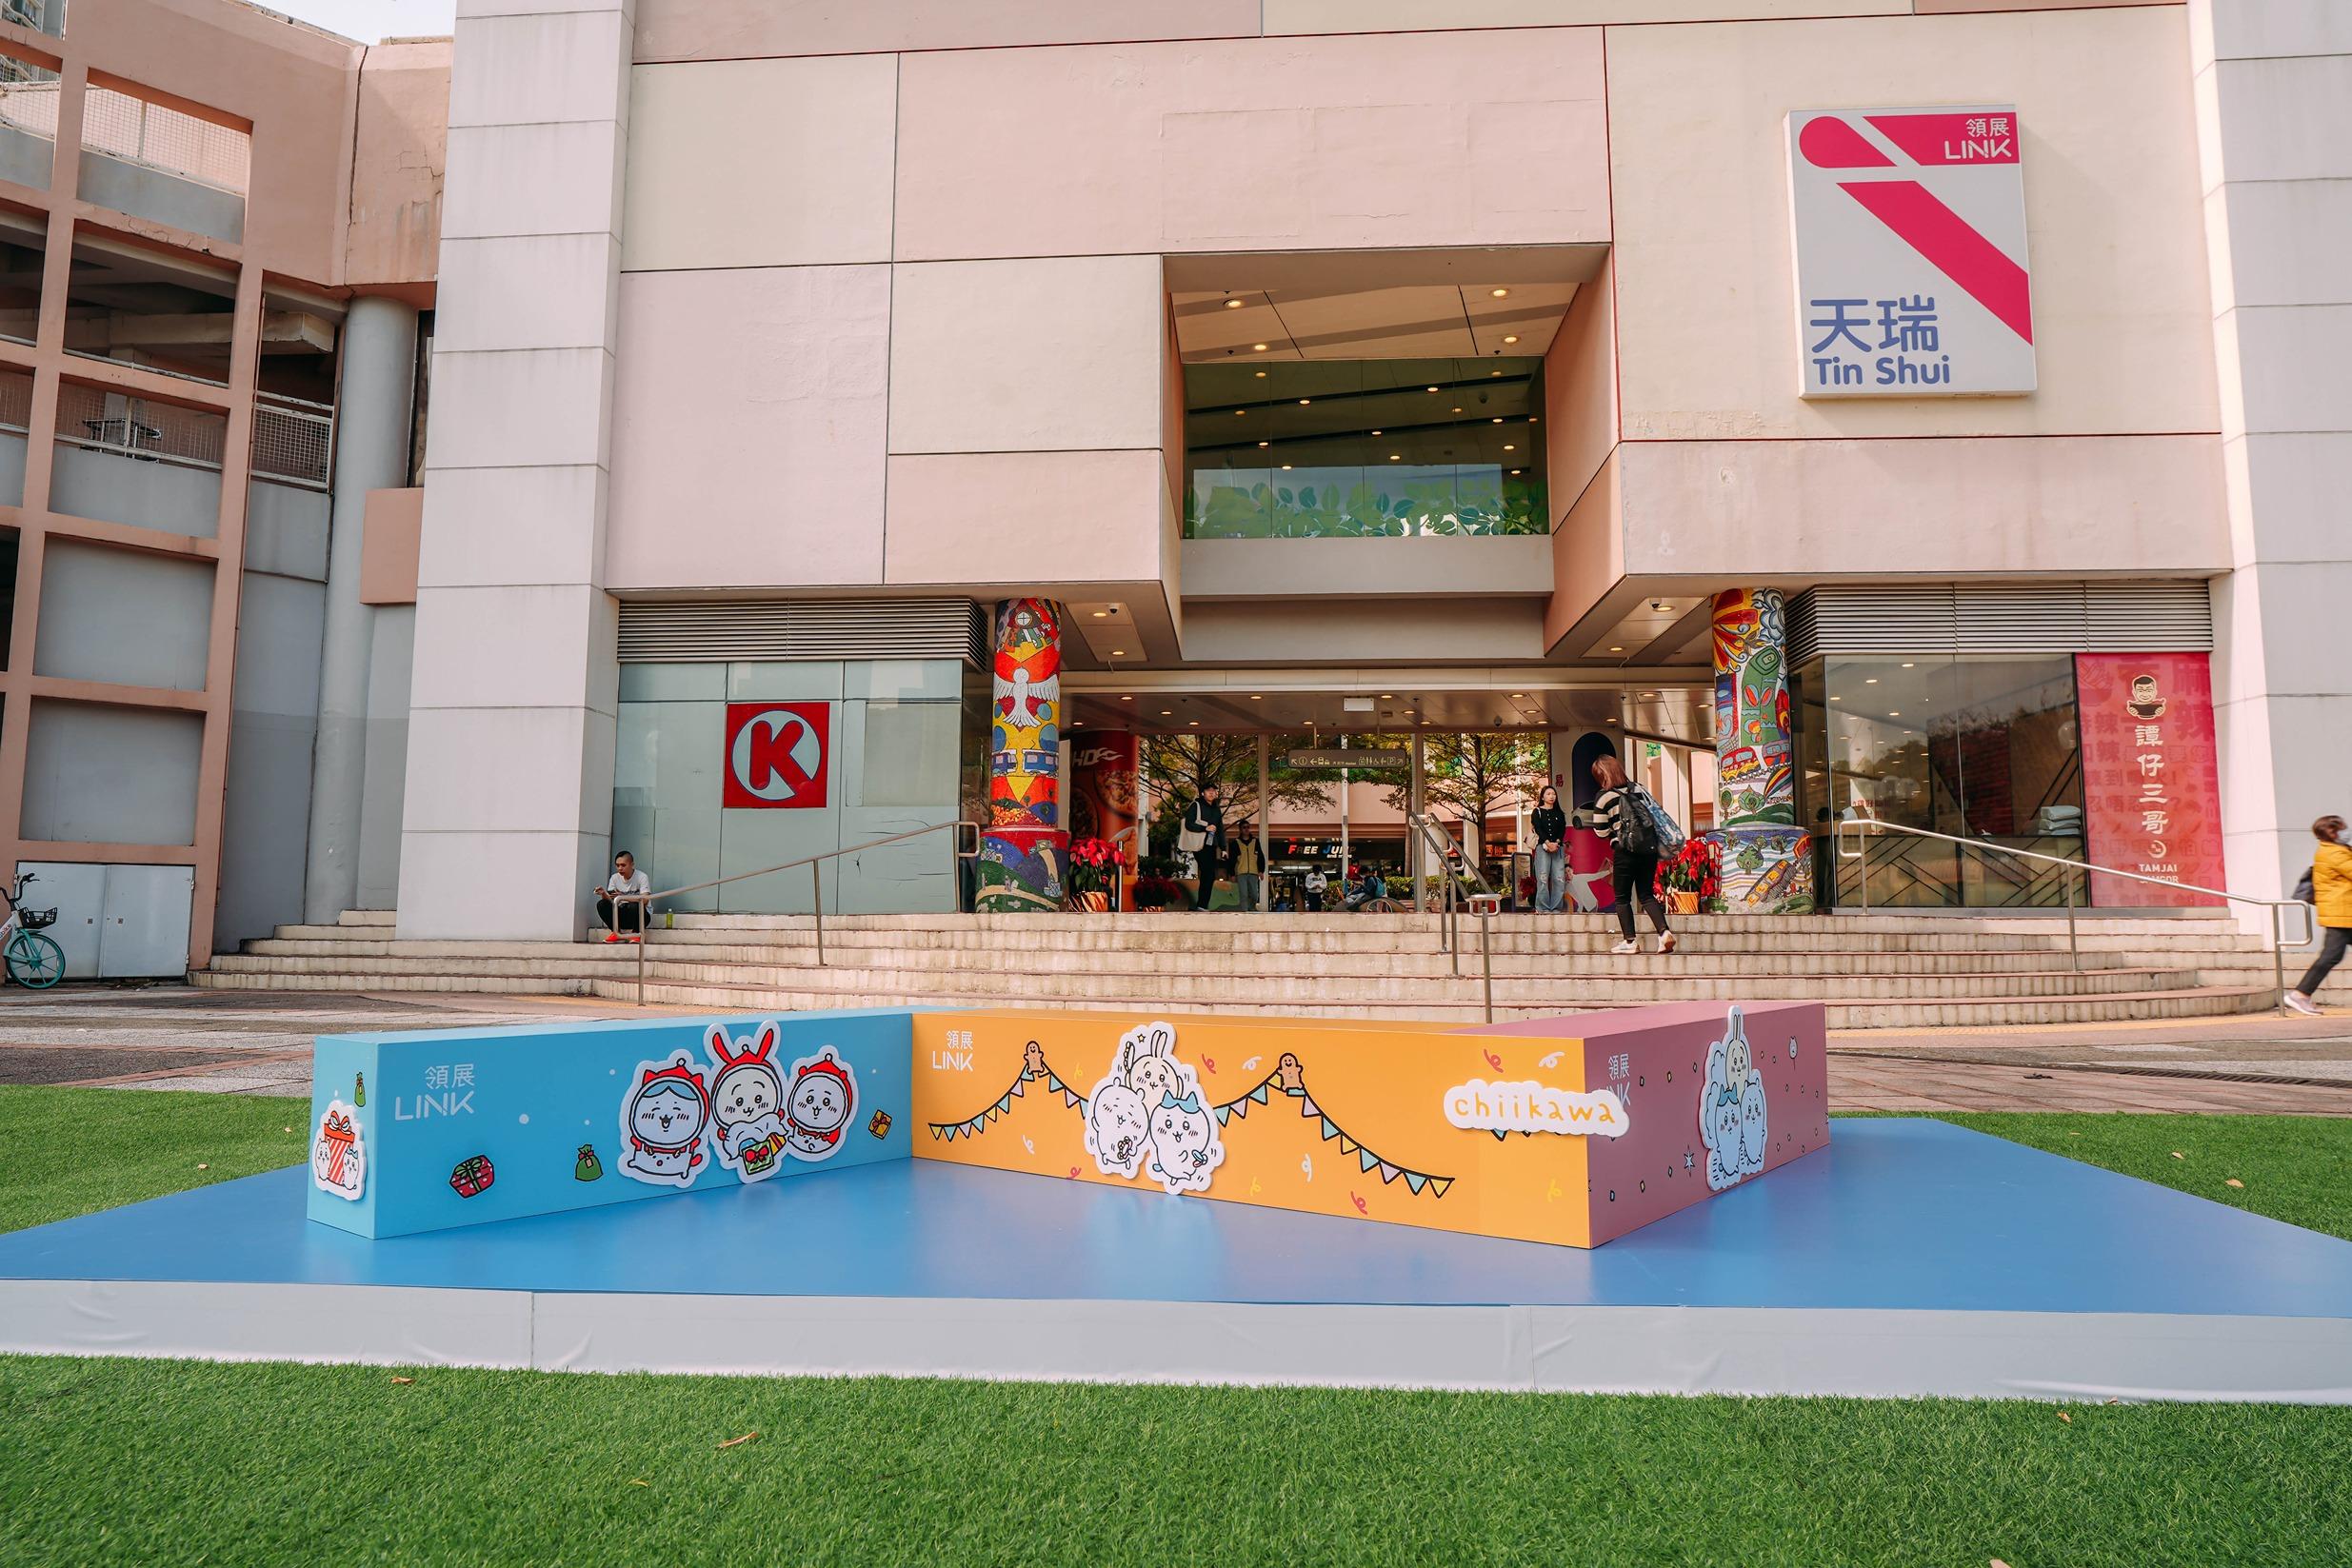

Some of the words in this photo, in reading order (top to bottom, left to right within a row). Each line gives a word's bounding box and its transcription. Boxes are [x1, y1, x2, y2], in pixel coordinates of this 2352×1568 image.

[1965, 117, 2010, 138] 領展
[1943, 138, 2012, 160] LINK
[1809, 294, 1939, 353] 天瑞
[1812, 356, 1864, 386] Tin
[1876, 355, 1950, 385] Shui
[748, 720, 814, 796] K
[2133, 724, 2169, 835] 譚仔三哥
[1323, 844, 1357, 855] JUP
[2139, 863, 2178, 873] TAMJAI
[947, 1030, 973, 1050] 領展
[932, 1050, 973, 1072] LINK
[1607, 1053, 1630, 1081] 領展
[425, 1063, 475, 1089] 領展
[394, 1090, 474, 1121] LINK
[1454, 1092, 1615, 1123] chiikawa
